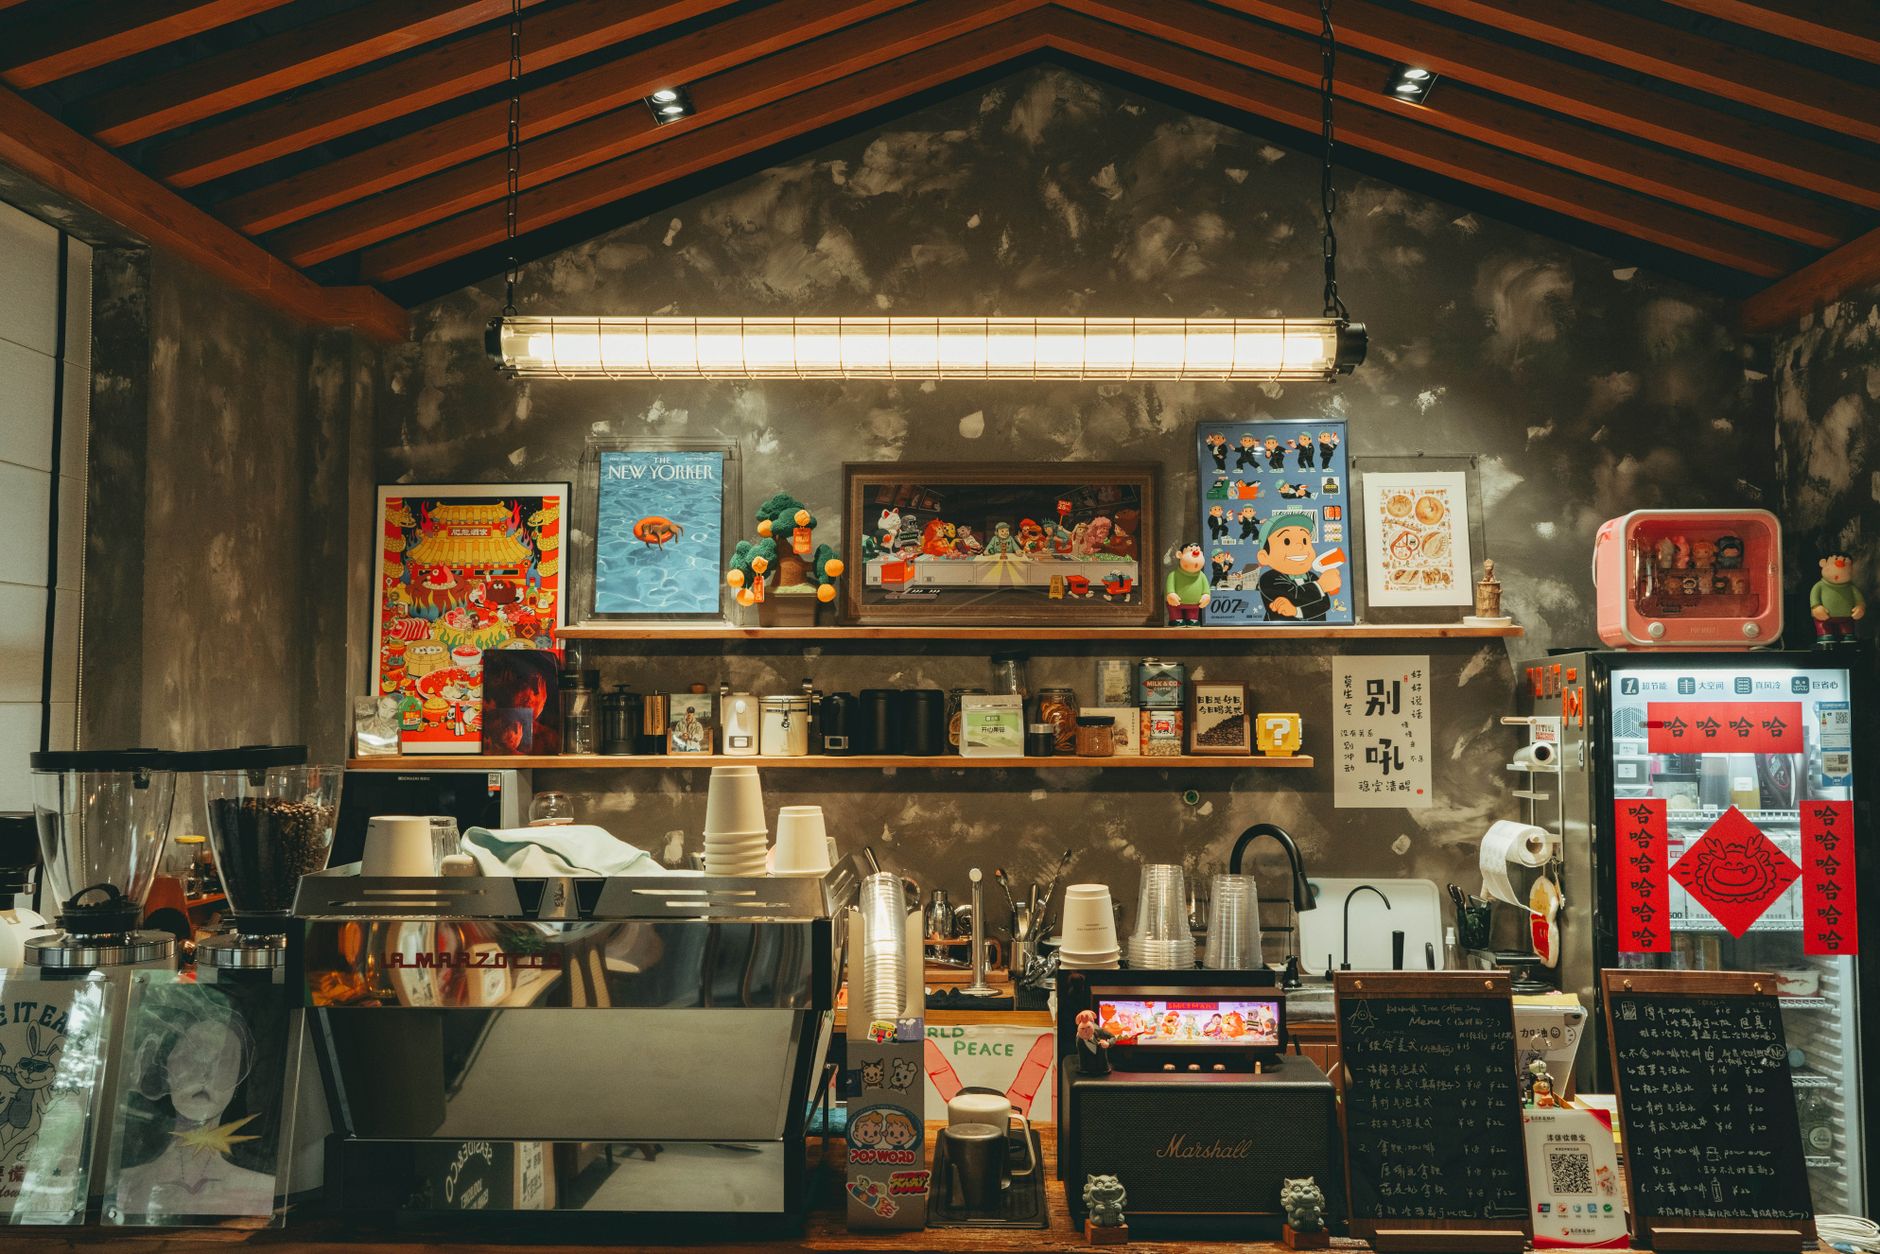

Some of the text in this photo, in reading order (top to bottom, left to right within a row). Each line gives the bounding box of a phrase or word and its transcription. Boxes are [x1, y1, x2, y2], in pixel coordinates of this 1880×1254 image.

[608, 464, 714, 481] NEW YORKER
[1210, 598, 1243, 614] 007
[1698, 681, 1724, 691] 大空间
[1410, 670, 1424, 720] 好好说话
[1663, 715, 1788, 738] 哈哈哈哈
[1358, 780, 1412, 793] 稳定清醒
[13, 1002, 37, 1023] IT
[953, 1040, 1015, 1057] PEACE
[1156, 1133, 1253, 1159] Marshall
